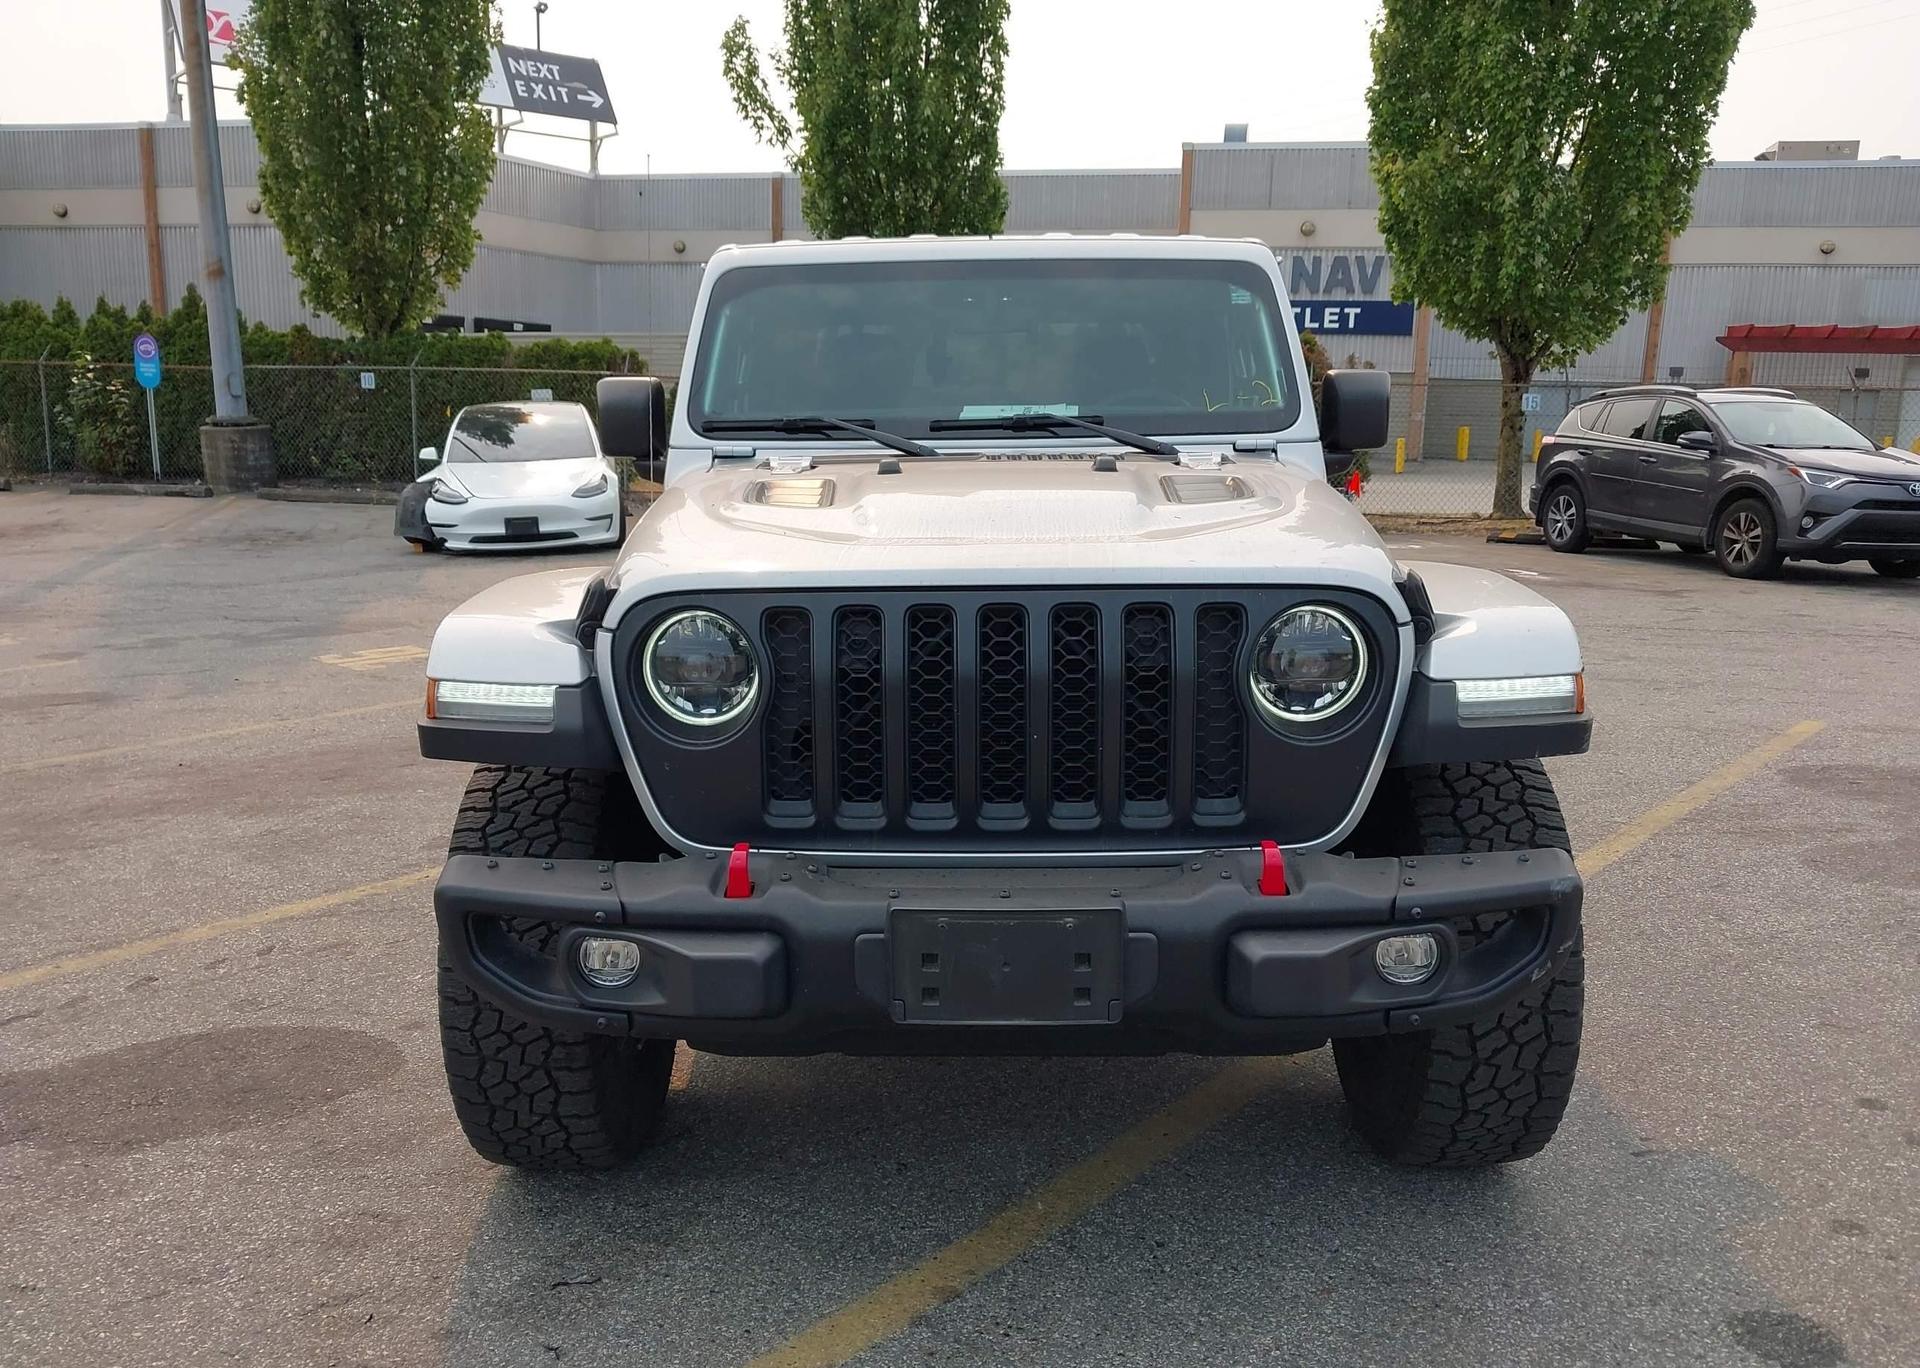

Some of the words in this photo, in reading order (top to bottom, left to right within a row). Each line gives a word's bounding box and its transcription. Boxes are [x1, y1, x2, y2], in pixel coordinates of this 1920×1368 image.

[507, 57, 560, 80] NEXT
[514, 80, 568, 103] EXIT
[1290, 255, 1393, 295] NAV
